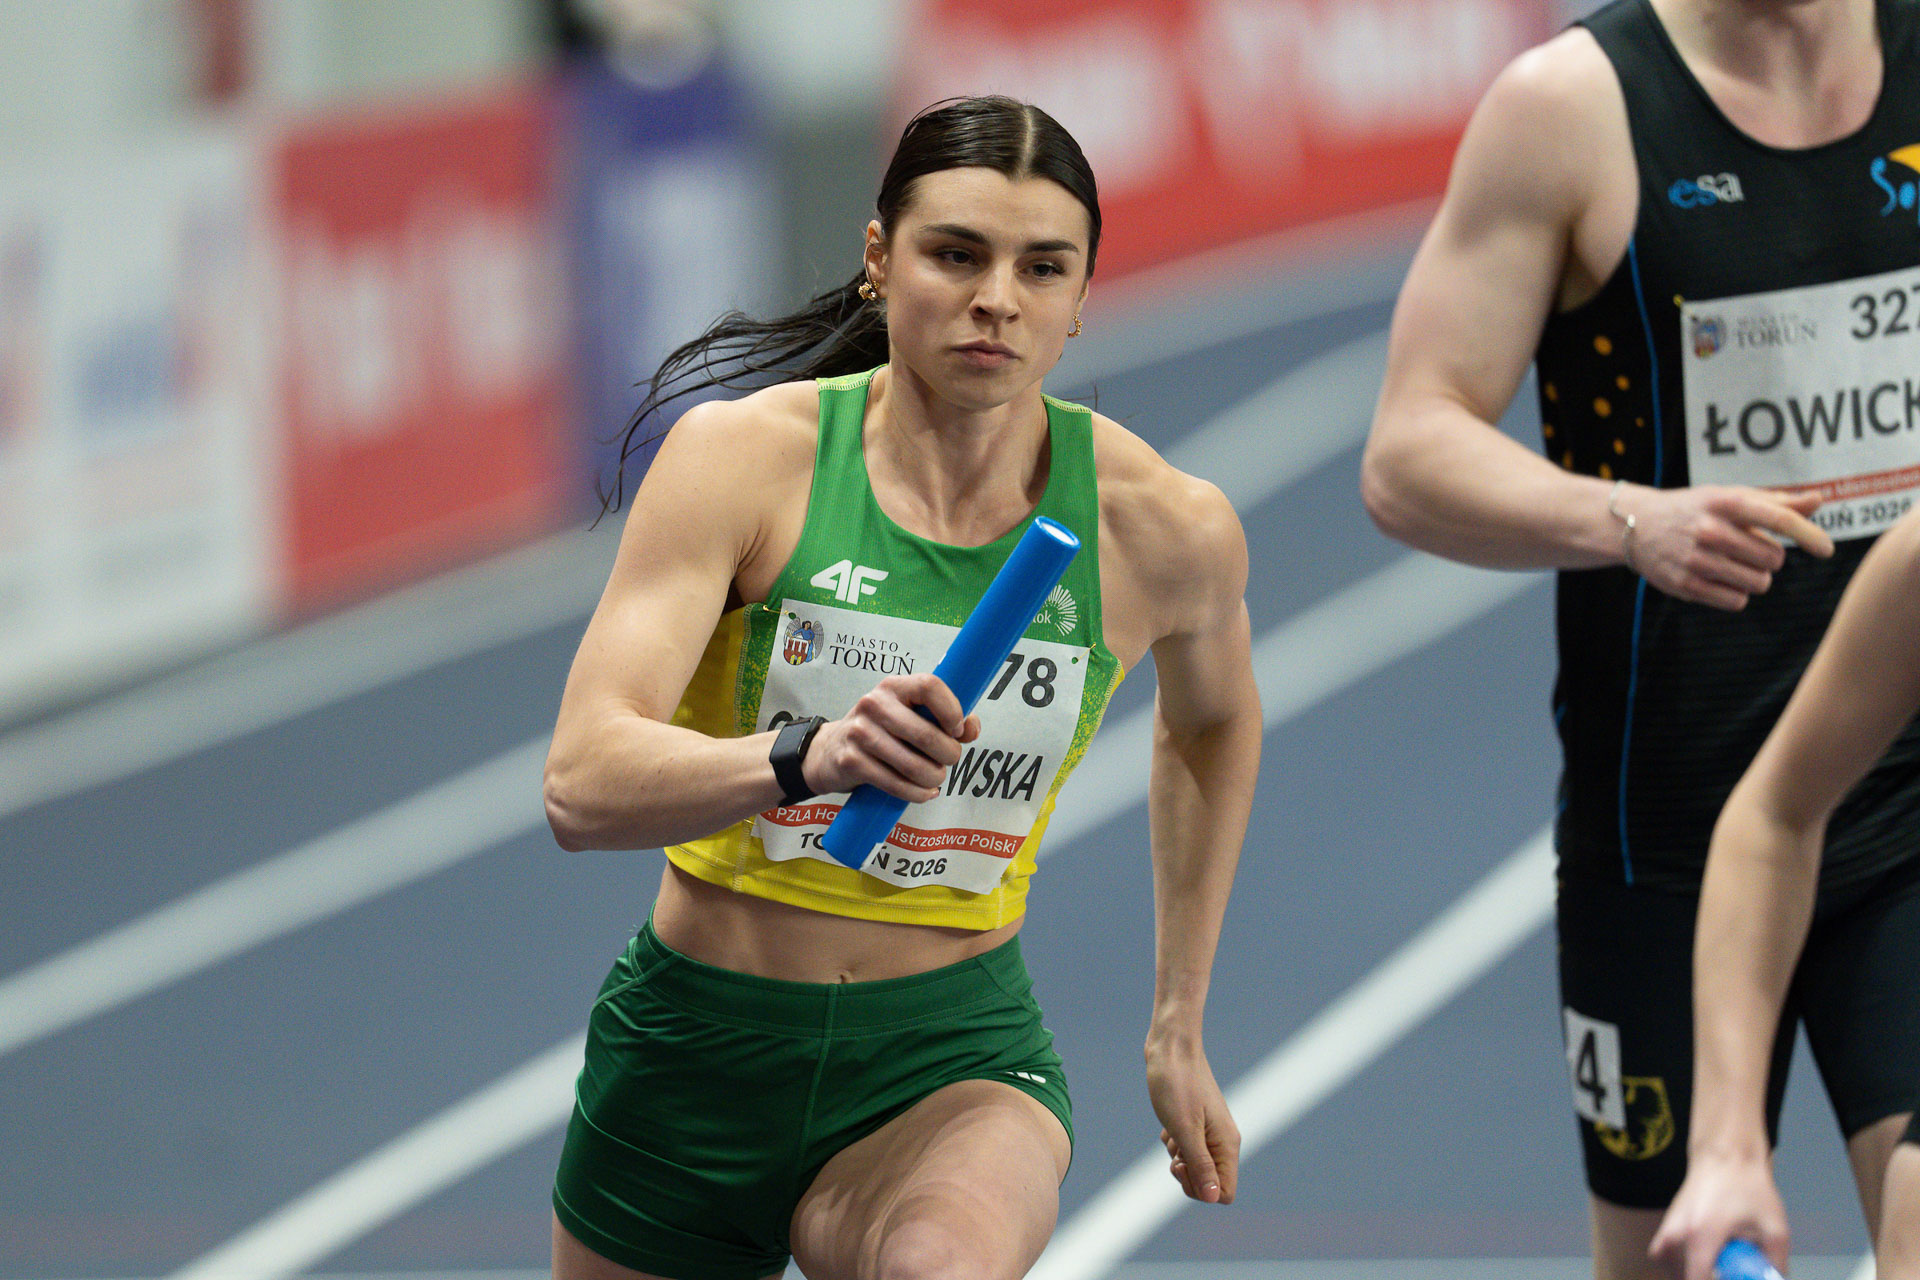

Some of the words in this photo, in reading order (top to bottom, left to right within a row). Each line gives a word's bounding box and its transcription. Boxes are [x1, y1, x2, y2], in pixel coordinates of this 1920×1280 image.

[810, 559, 889, 605] 4F
[829, 646, 916, 676] TORUŃ
[836, 632, 899, 652] MIASTO
[987, 652, 1058, 708] 78
[776, 807, 811, 822] PZLA
[969, 834, 1017, 854] Polski
[893, 857, 948, 878] 2026
[1576, 1028, 1607, 1113] 4
